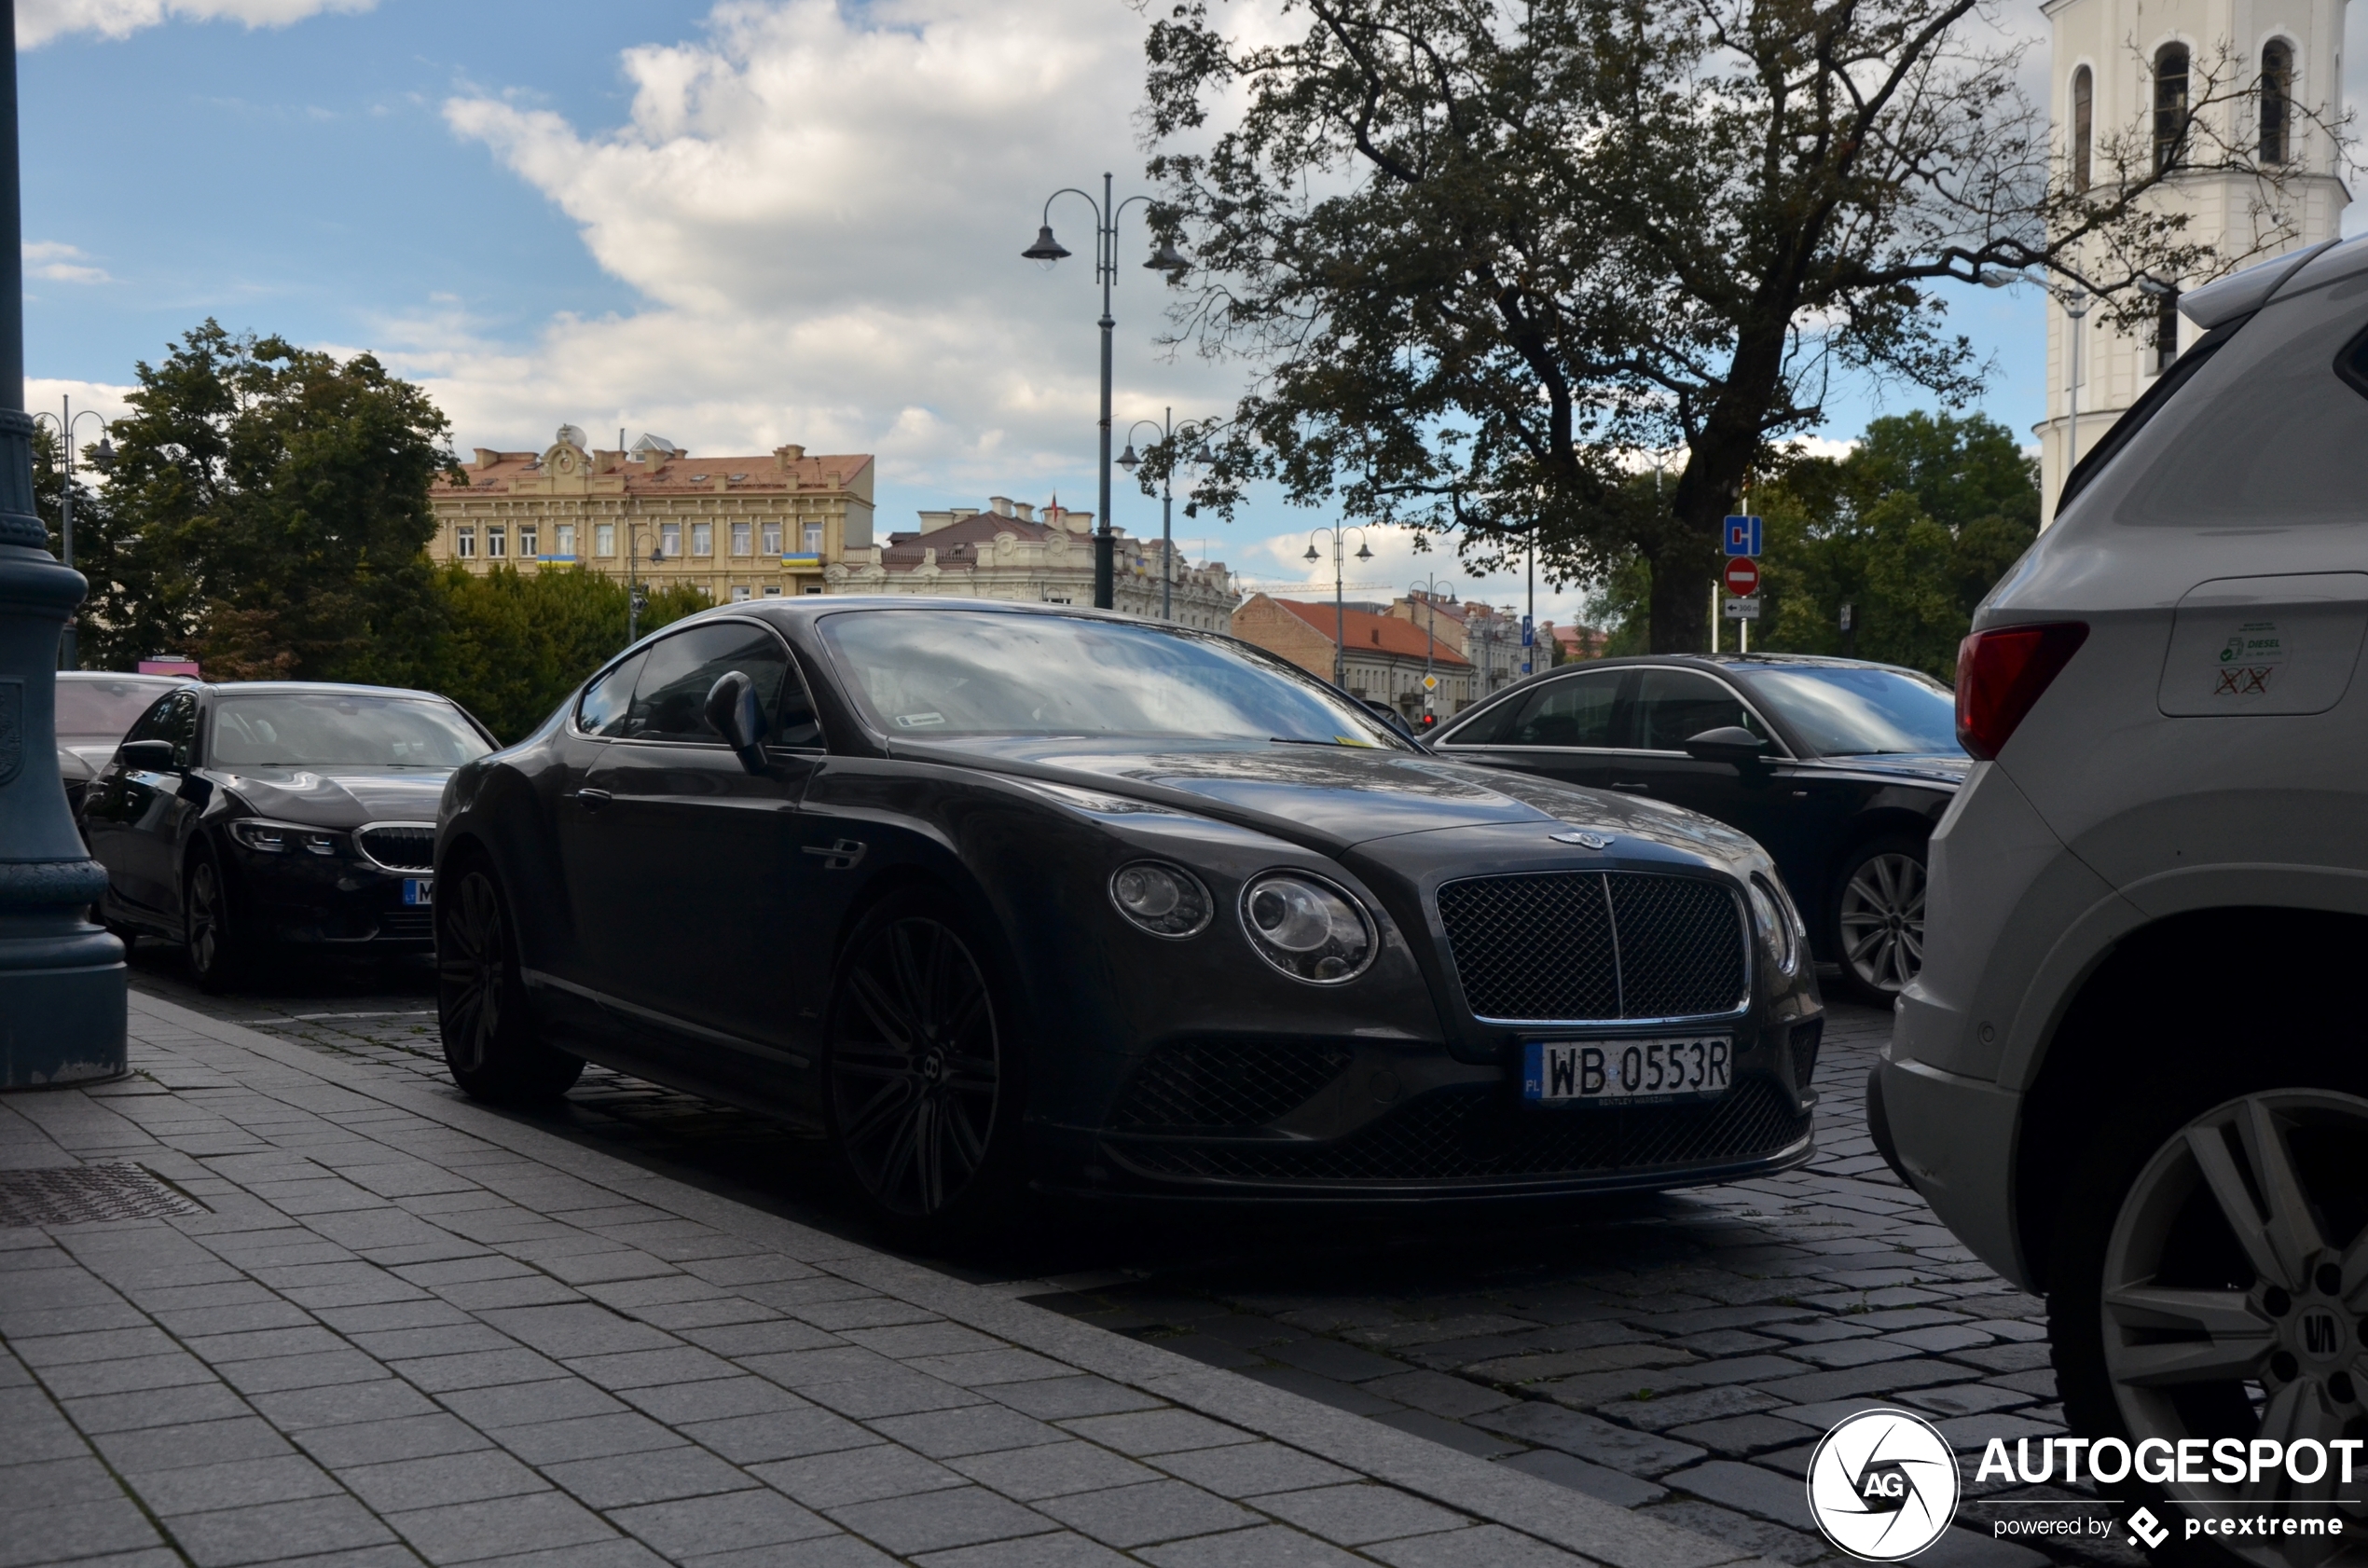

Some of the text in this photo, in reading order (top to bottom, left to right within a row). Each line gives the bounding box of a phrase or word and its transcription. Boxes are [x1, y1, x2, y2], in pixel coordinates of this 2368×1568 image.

[1739, 604, 1752, 612] 300
[1524, 618, 1532, 643] P
[2247, 639, 2280, 649] DIESEL
[1549, 1040, 1728, 1095] WB 0553R
[1525, 1080, 1539, 1092] PL
[1598, 1094, 1673, 1107] BENTLEY WARSZAWA
